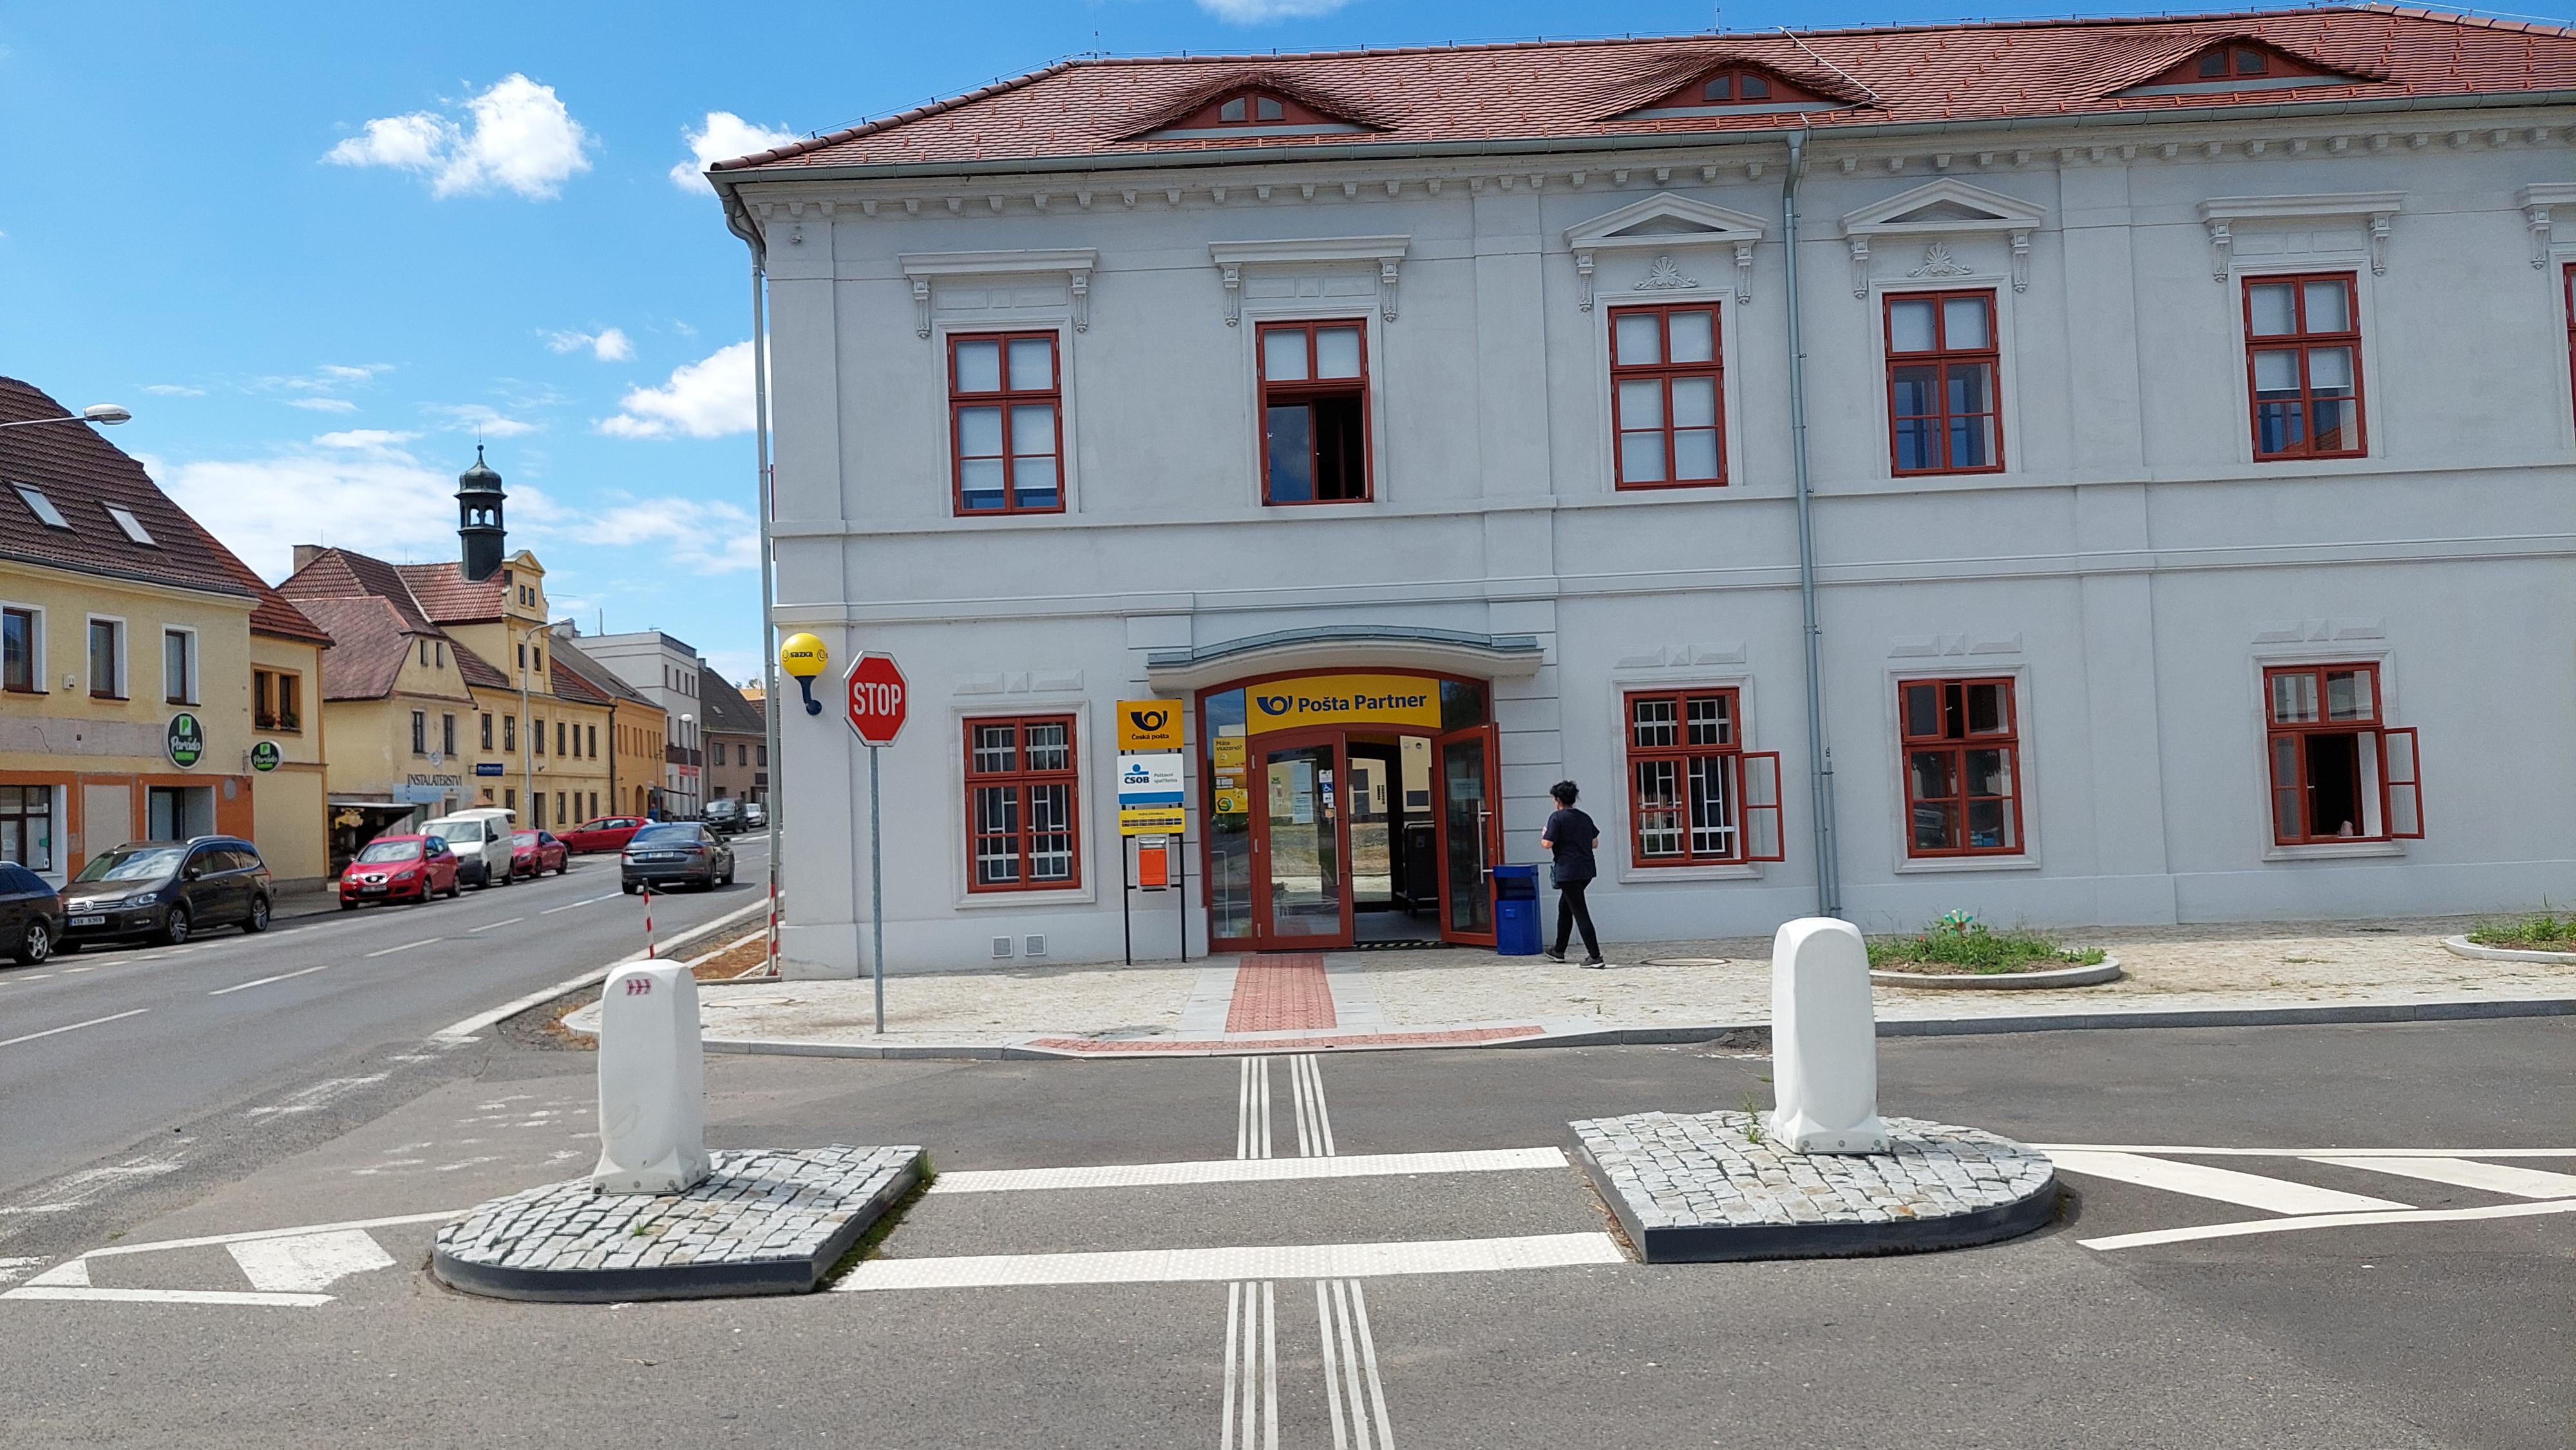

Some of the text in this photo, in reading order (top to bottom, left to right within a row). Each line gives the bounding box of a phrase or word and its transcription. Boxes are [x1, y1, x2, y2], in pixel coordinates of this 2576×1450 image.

[853, 682, 902, 717] STOP
[1298, 694, 1427, 713] Pošta Partner
